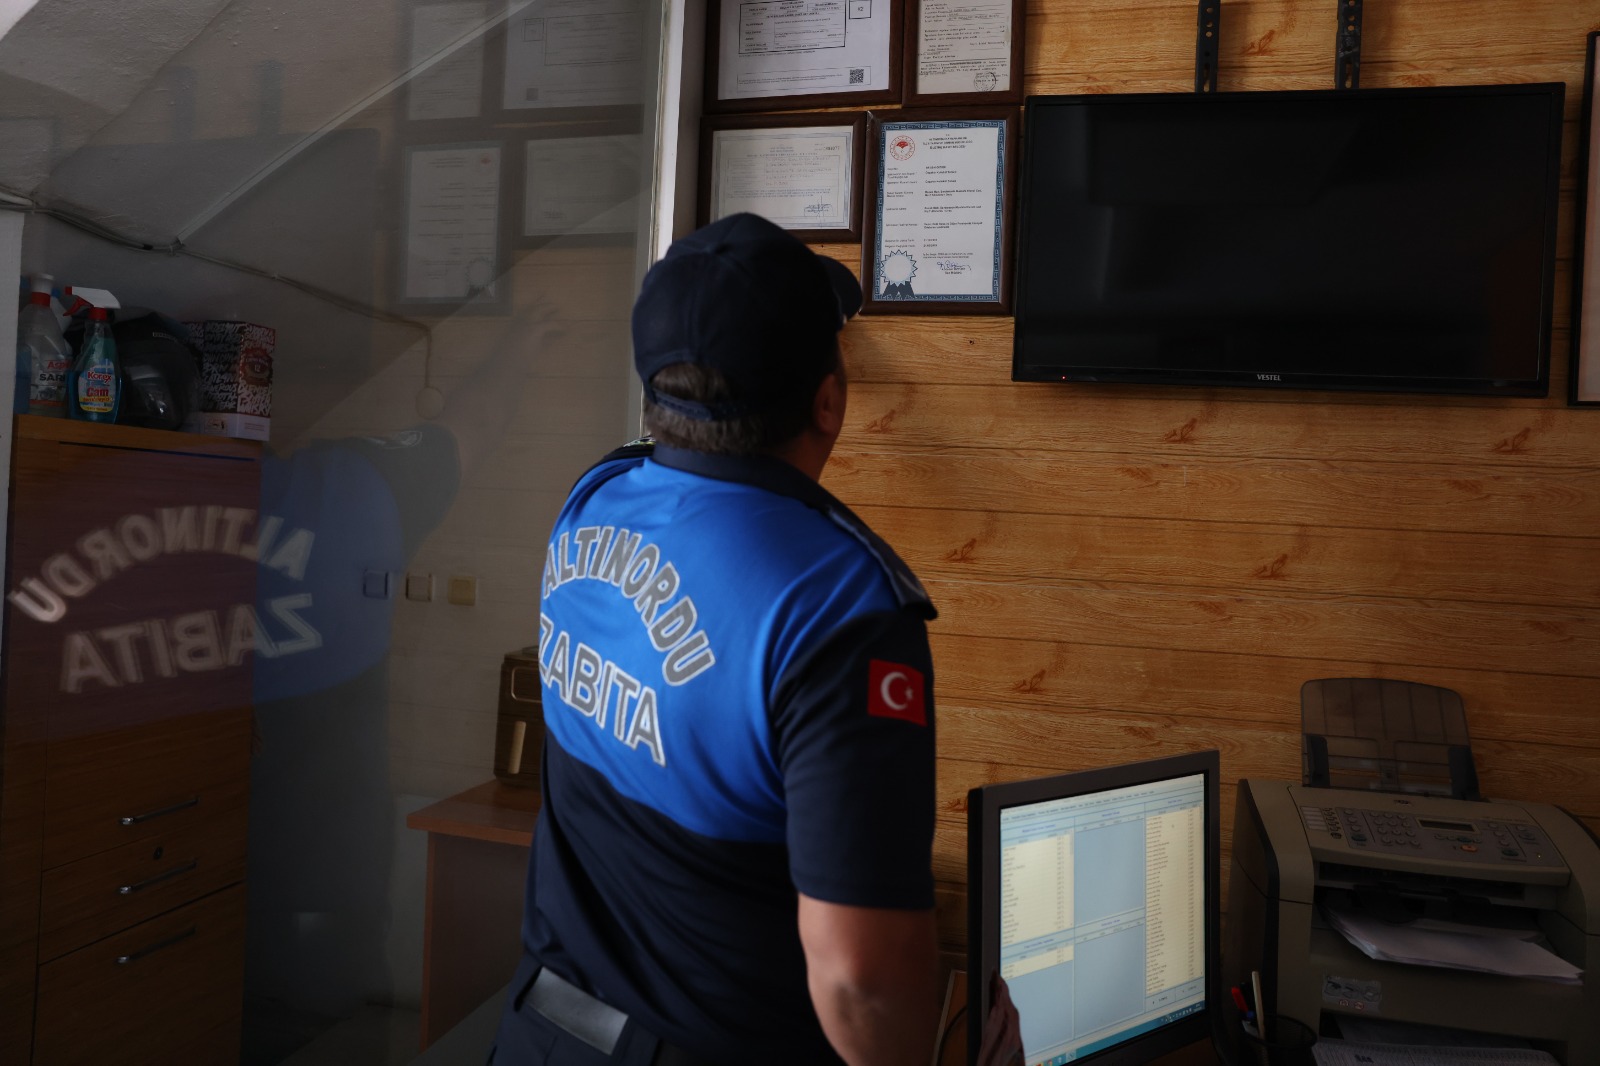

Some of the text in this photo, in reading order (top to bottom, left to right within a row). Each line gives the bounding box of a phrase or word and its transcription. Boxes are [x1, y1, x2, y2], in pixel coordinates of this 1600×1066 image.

[87, 371, 113, 384] Korex
[1256, 373, 1282, 382] VESTEL
[87, 387, 109, 397] Cam
[542, 524, 717, 688] ALTINORDU
[538, 611, 667, 768] ZABITA
